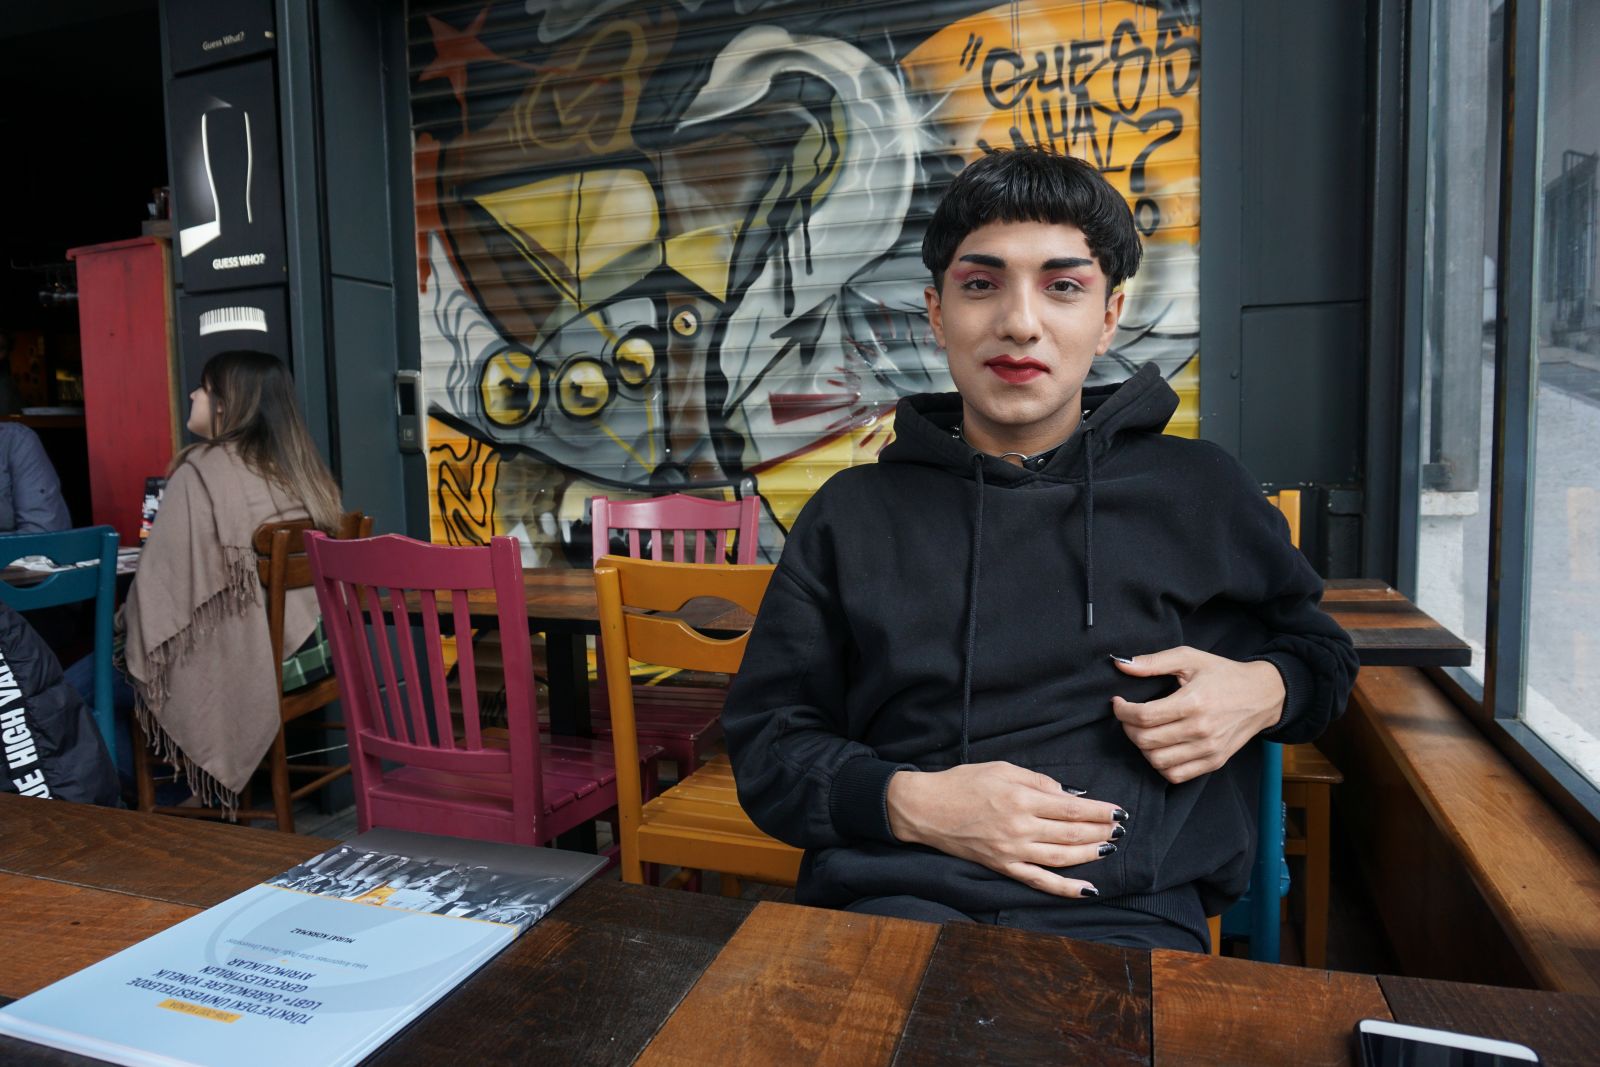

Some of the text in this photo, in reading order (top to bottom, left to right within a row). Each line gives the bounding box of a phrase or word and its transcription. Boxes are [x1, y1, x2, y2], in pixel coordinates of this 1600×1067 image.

[202, 31, 245, 50] Guess What?
[212, 252, 266, 270] GUESS WHO?
[1, 707, 38, 769] HIGH
